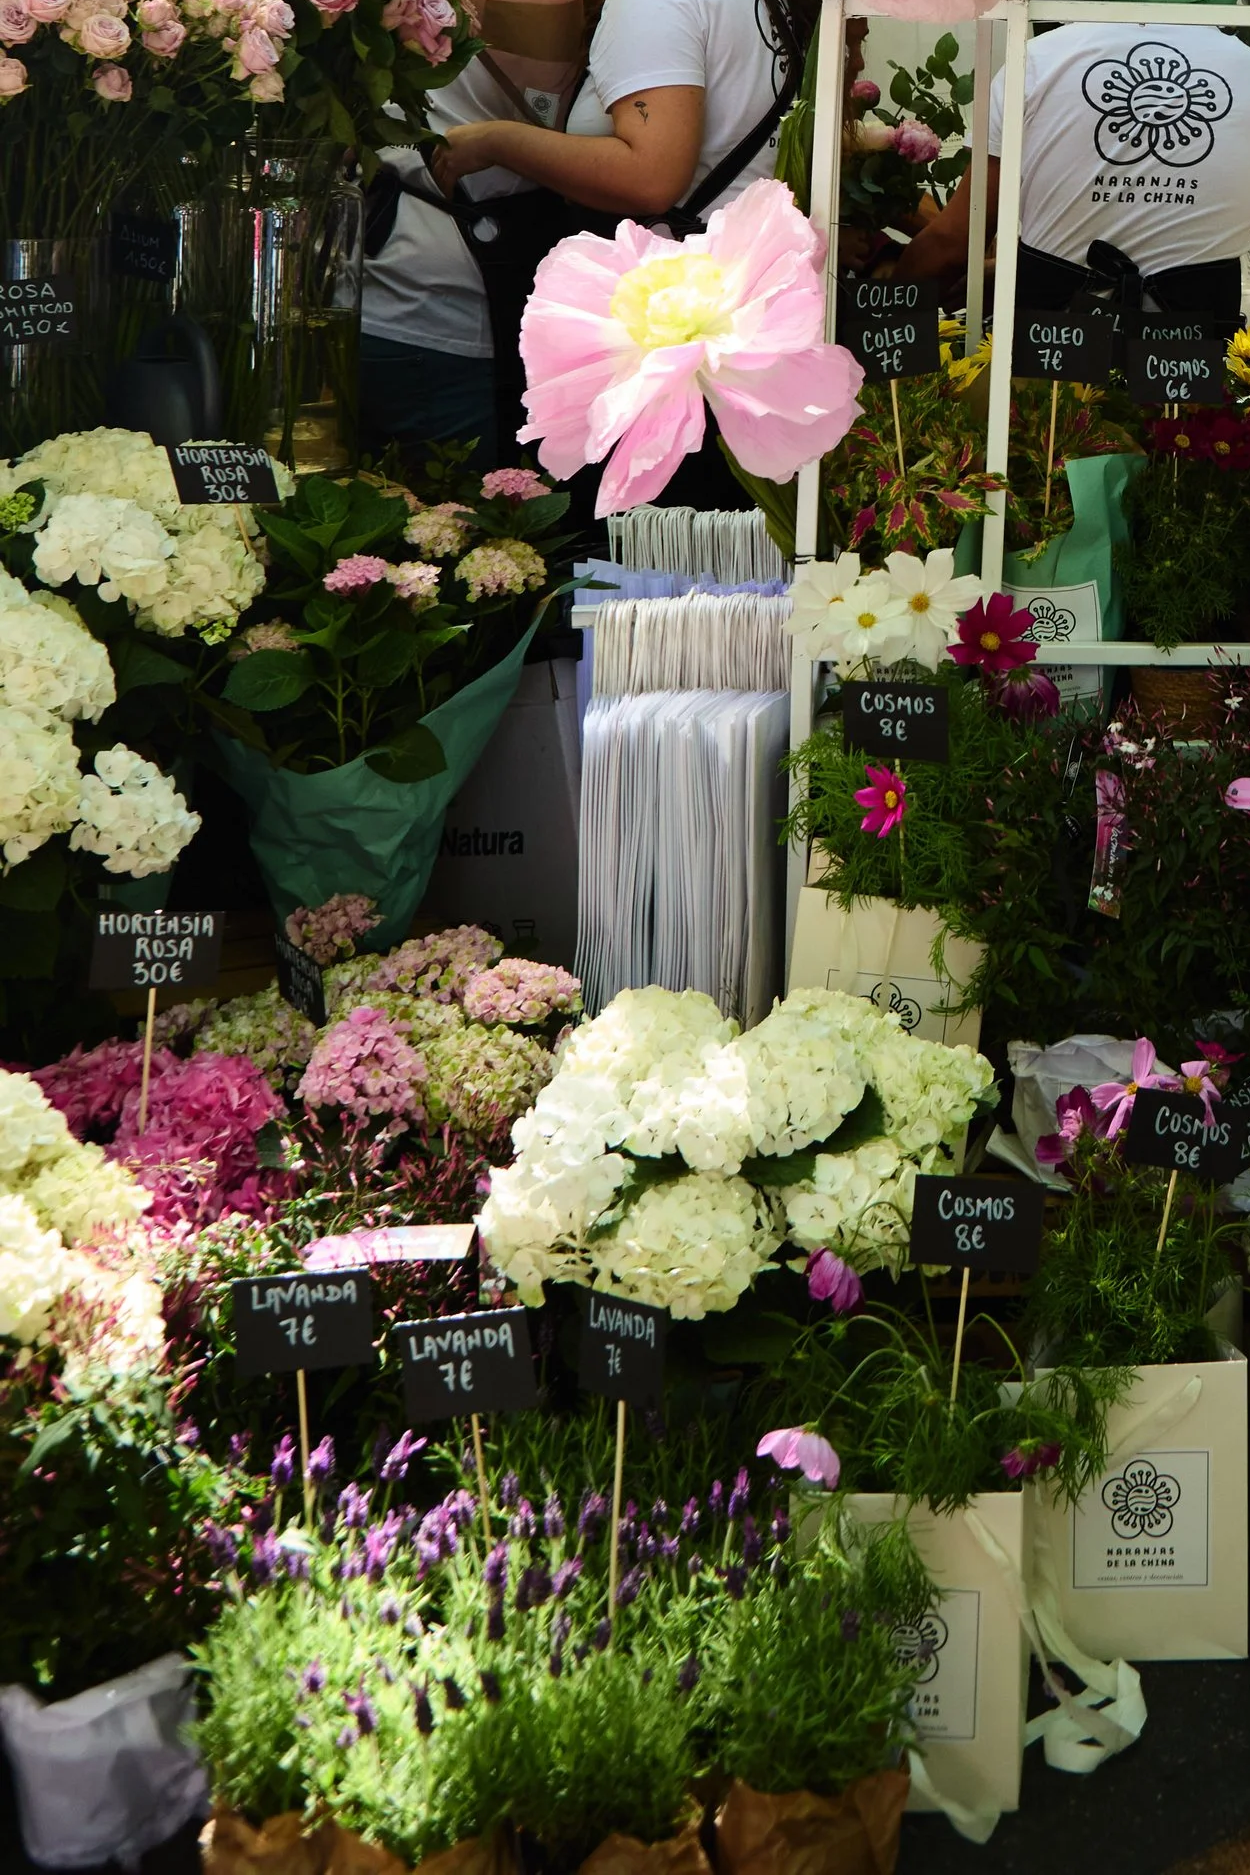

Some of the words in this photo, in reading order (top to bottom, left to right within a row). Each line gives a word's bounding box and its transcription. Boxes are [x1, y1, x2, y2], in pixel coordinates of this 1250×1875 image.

[1094, 176, 1199, 190] NARANJAS
[1091, 192, 1110, 203] DE
[1117, 192, 1135, 203] LA
[1143, 192, 1195, 205] CHINA
[857, 283, 919, 309] COLEO
[862, 324, 916, 353] COLEO
[1029, 323, 1084, 347] COLEO
[876, 348, 903, 374] 7€
[1037, 348, 1063, 371] 7€
[1146, 354, 1210, 381] COSMOS
[1165, 379, 1191, 400] 6€
[200, 465, 250, 485] ROSA
[204, 484, 249, 503] 30€
[860, 691, 935, 716] COSMOS
[879, 717, 908, 741] 8€
[443, 827, 525, 856] Natura
[134, 936, 194, 961] ROSA
[131, 961, 183, 985] 30€
[1155, 1105, 1231, 1147] COSMOS
[1174, 1141, 1201, 1168] 8€
[938, 1189, 1015, 1221] COSMOS
[954, 1223, 986, 1251] 8€
[251, 1279, 357, 1315] LAVANDA
[279, 1314, 317, 1346] 7€
[589, 1296, 656, 1348] LAVANDA
[409, 1322, 514, 1361] LAVANDA
[605, 1343, 621, 1377] 7€
[438, 1359, 474, 1391] 7€
[1106, 1547, 1174, 1556] NARANJAS
[1106, 1559, 1120, 1567] DE
[1124, 1559, 1136, 1567] LA
[1141, 1559, 1175, 1567] CHINA
